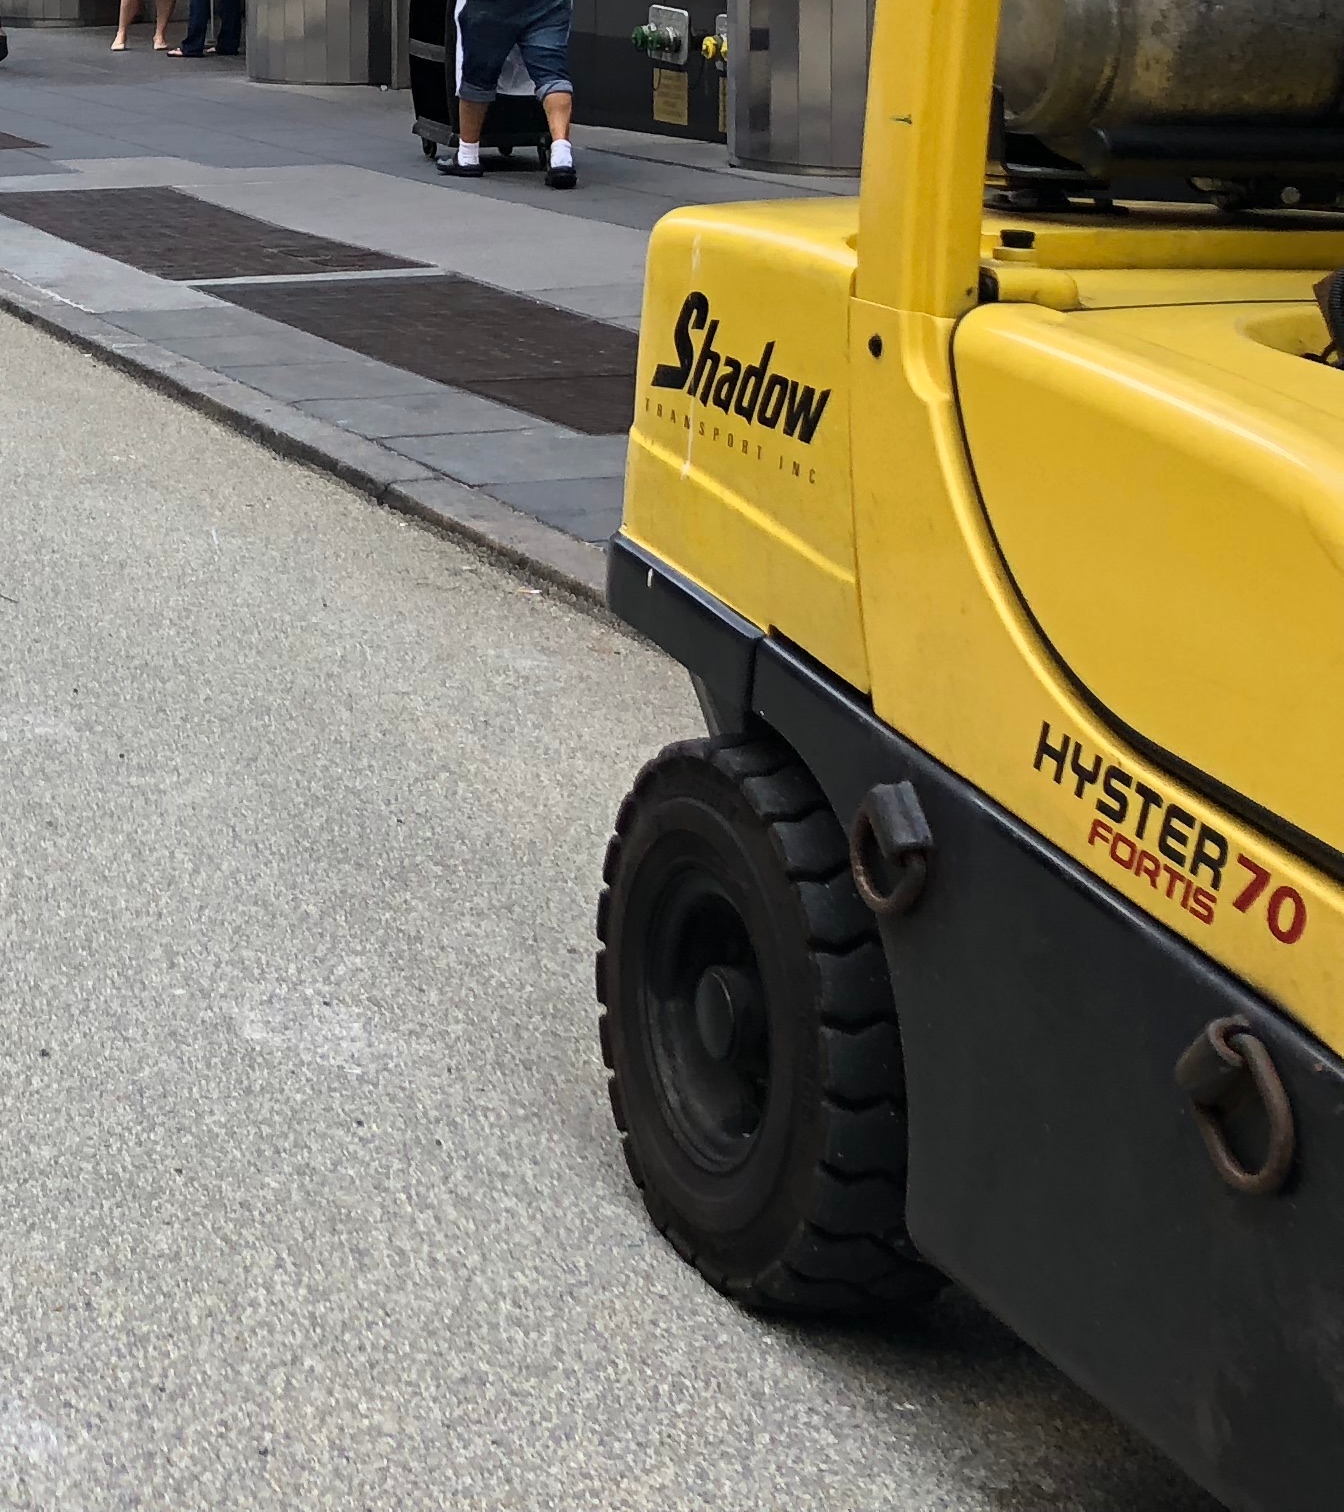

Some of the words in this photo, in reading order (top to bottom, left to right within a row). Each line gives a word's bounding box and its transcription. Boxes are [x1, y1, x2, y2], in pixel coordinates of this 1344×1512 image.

[651, 291, 832, 445] Shadow
[645, 397, 762, 461] TRANSPORT
[778, 455, 817, 485] INC
[1032, 719, 1229, 892] HYSTER
[1087, 818, 1218, 926] FORTIS
[1232, 852, 1309, 946] 70
